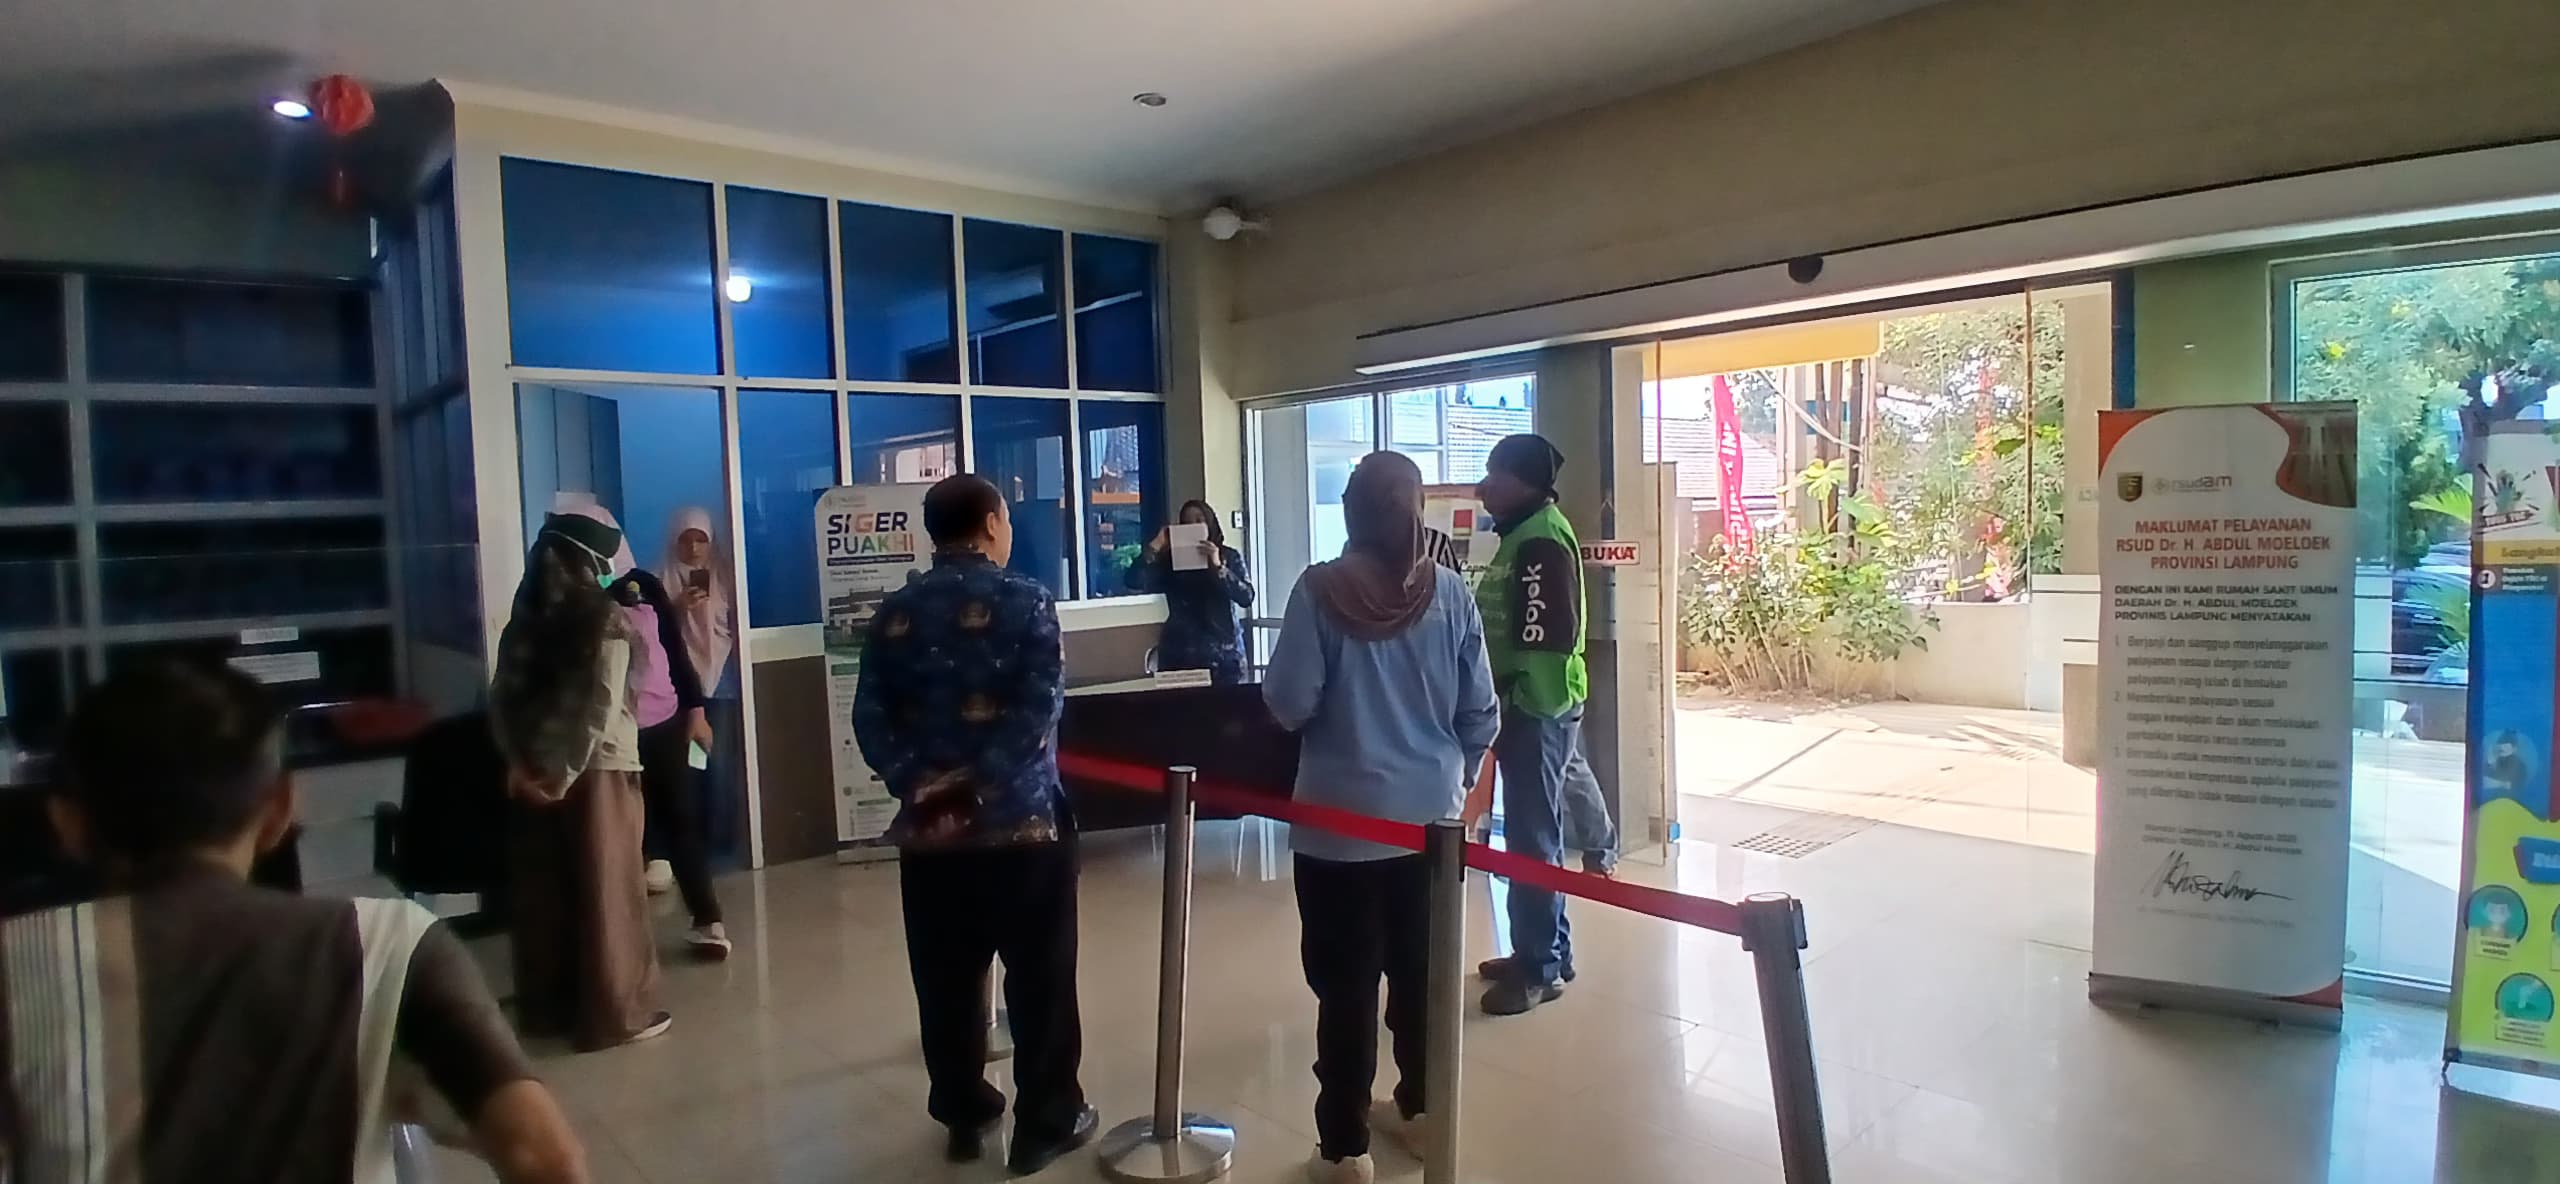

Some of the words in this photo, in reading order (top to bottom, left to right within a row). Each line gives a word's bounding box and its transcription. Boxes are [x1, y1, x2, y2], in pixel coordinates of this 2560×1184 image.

[827, 512, 908, 534] SIGER
[2135, 519, 2218, 534] MAKLUMAT
[2223, 518, 2312, 531] PELAYANAN
[828, 533, 914, 555] PUAKHI
[2117, 539, 2154, 552] RSUD
[2203, 538, 2252, 551] ABDUL
[2258, 537, 2330, 550] MOELOEK
[1580, 546, 1636, 560] BUKA
[2151, 557, 2218, 569] PROVINSI
[2224, 556, 2298, 569] LAMPUNG
[2115, 585, 2162, 594] DENGAN
[2166, 585, 2181, 594] INI
[2184, 585, 2213, 594] KAMI
[2216, 585, 2259, 594] RUMAH
[2263, 585, 2296, 594] SAKIT
[2301, 585, 2338, 595] UMUM
[2115, 598, 2161, 607] DAERAH
[2198, 599, 2238, 607] ABDUL
[2231, 612, 2311, 622] MENYATAKAN
